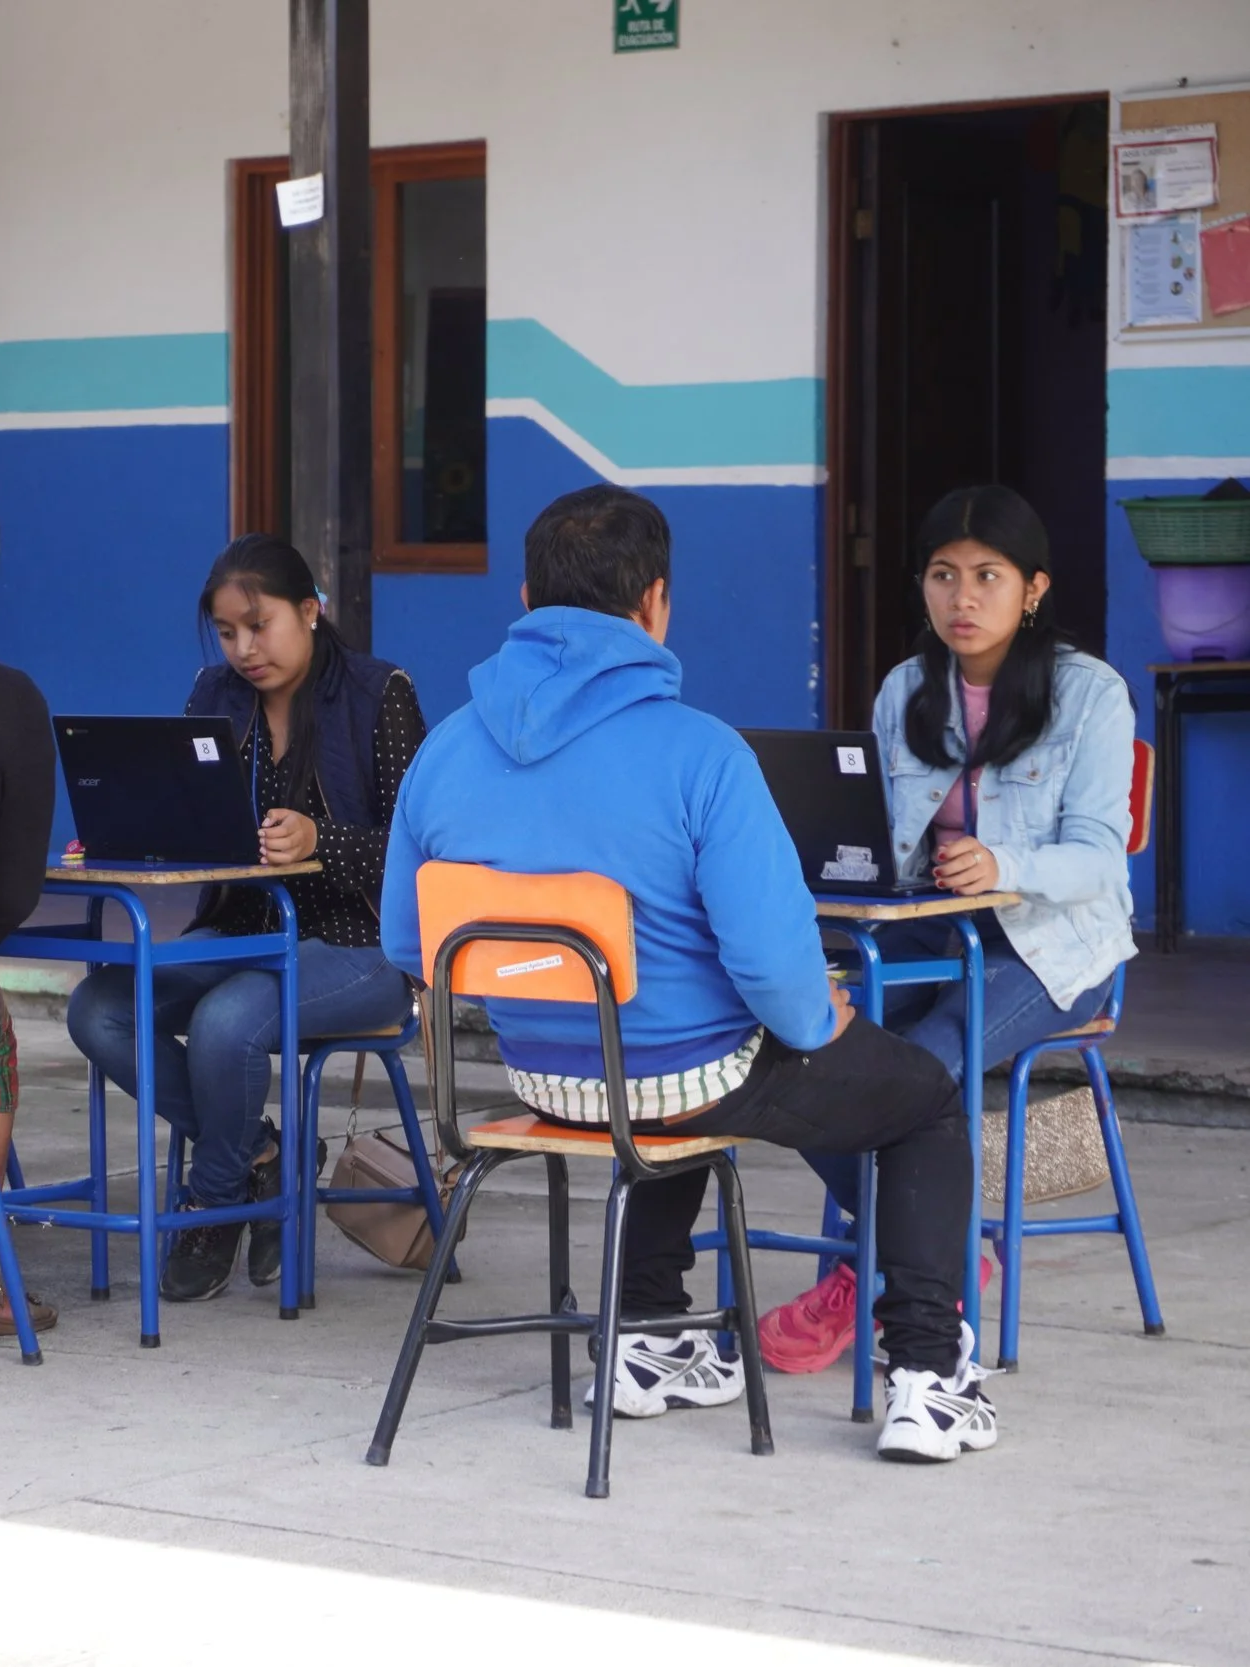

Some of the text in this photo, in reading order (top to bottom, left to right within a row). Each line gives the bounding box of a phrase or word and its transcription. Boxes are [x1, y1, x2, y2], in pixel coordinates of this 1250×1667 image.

[628, 18, 665, 32] RUTA DE
[202, 743, 210, 755] 8
[847, 753, 856, 766] 8
[78, 778, 101, 787] acer
